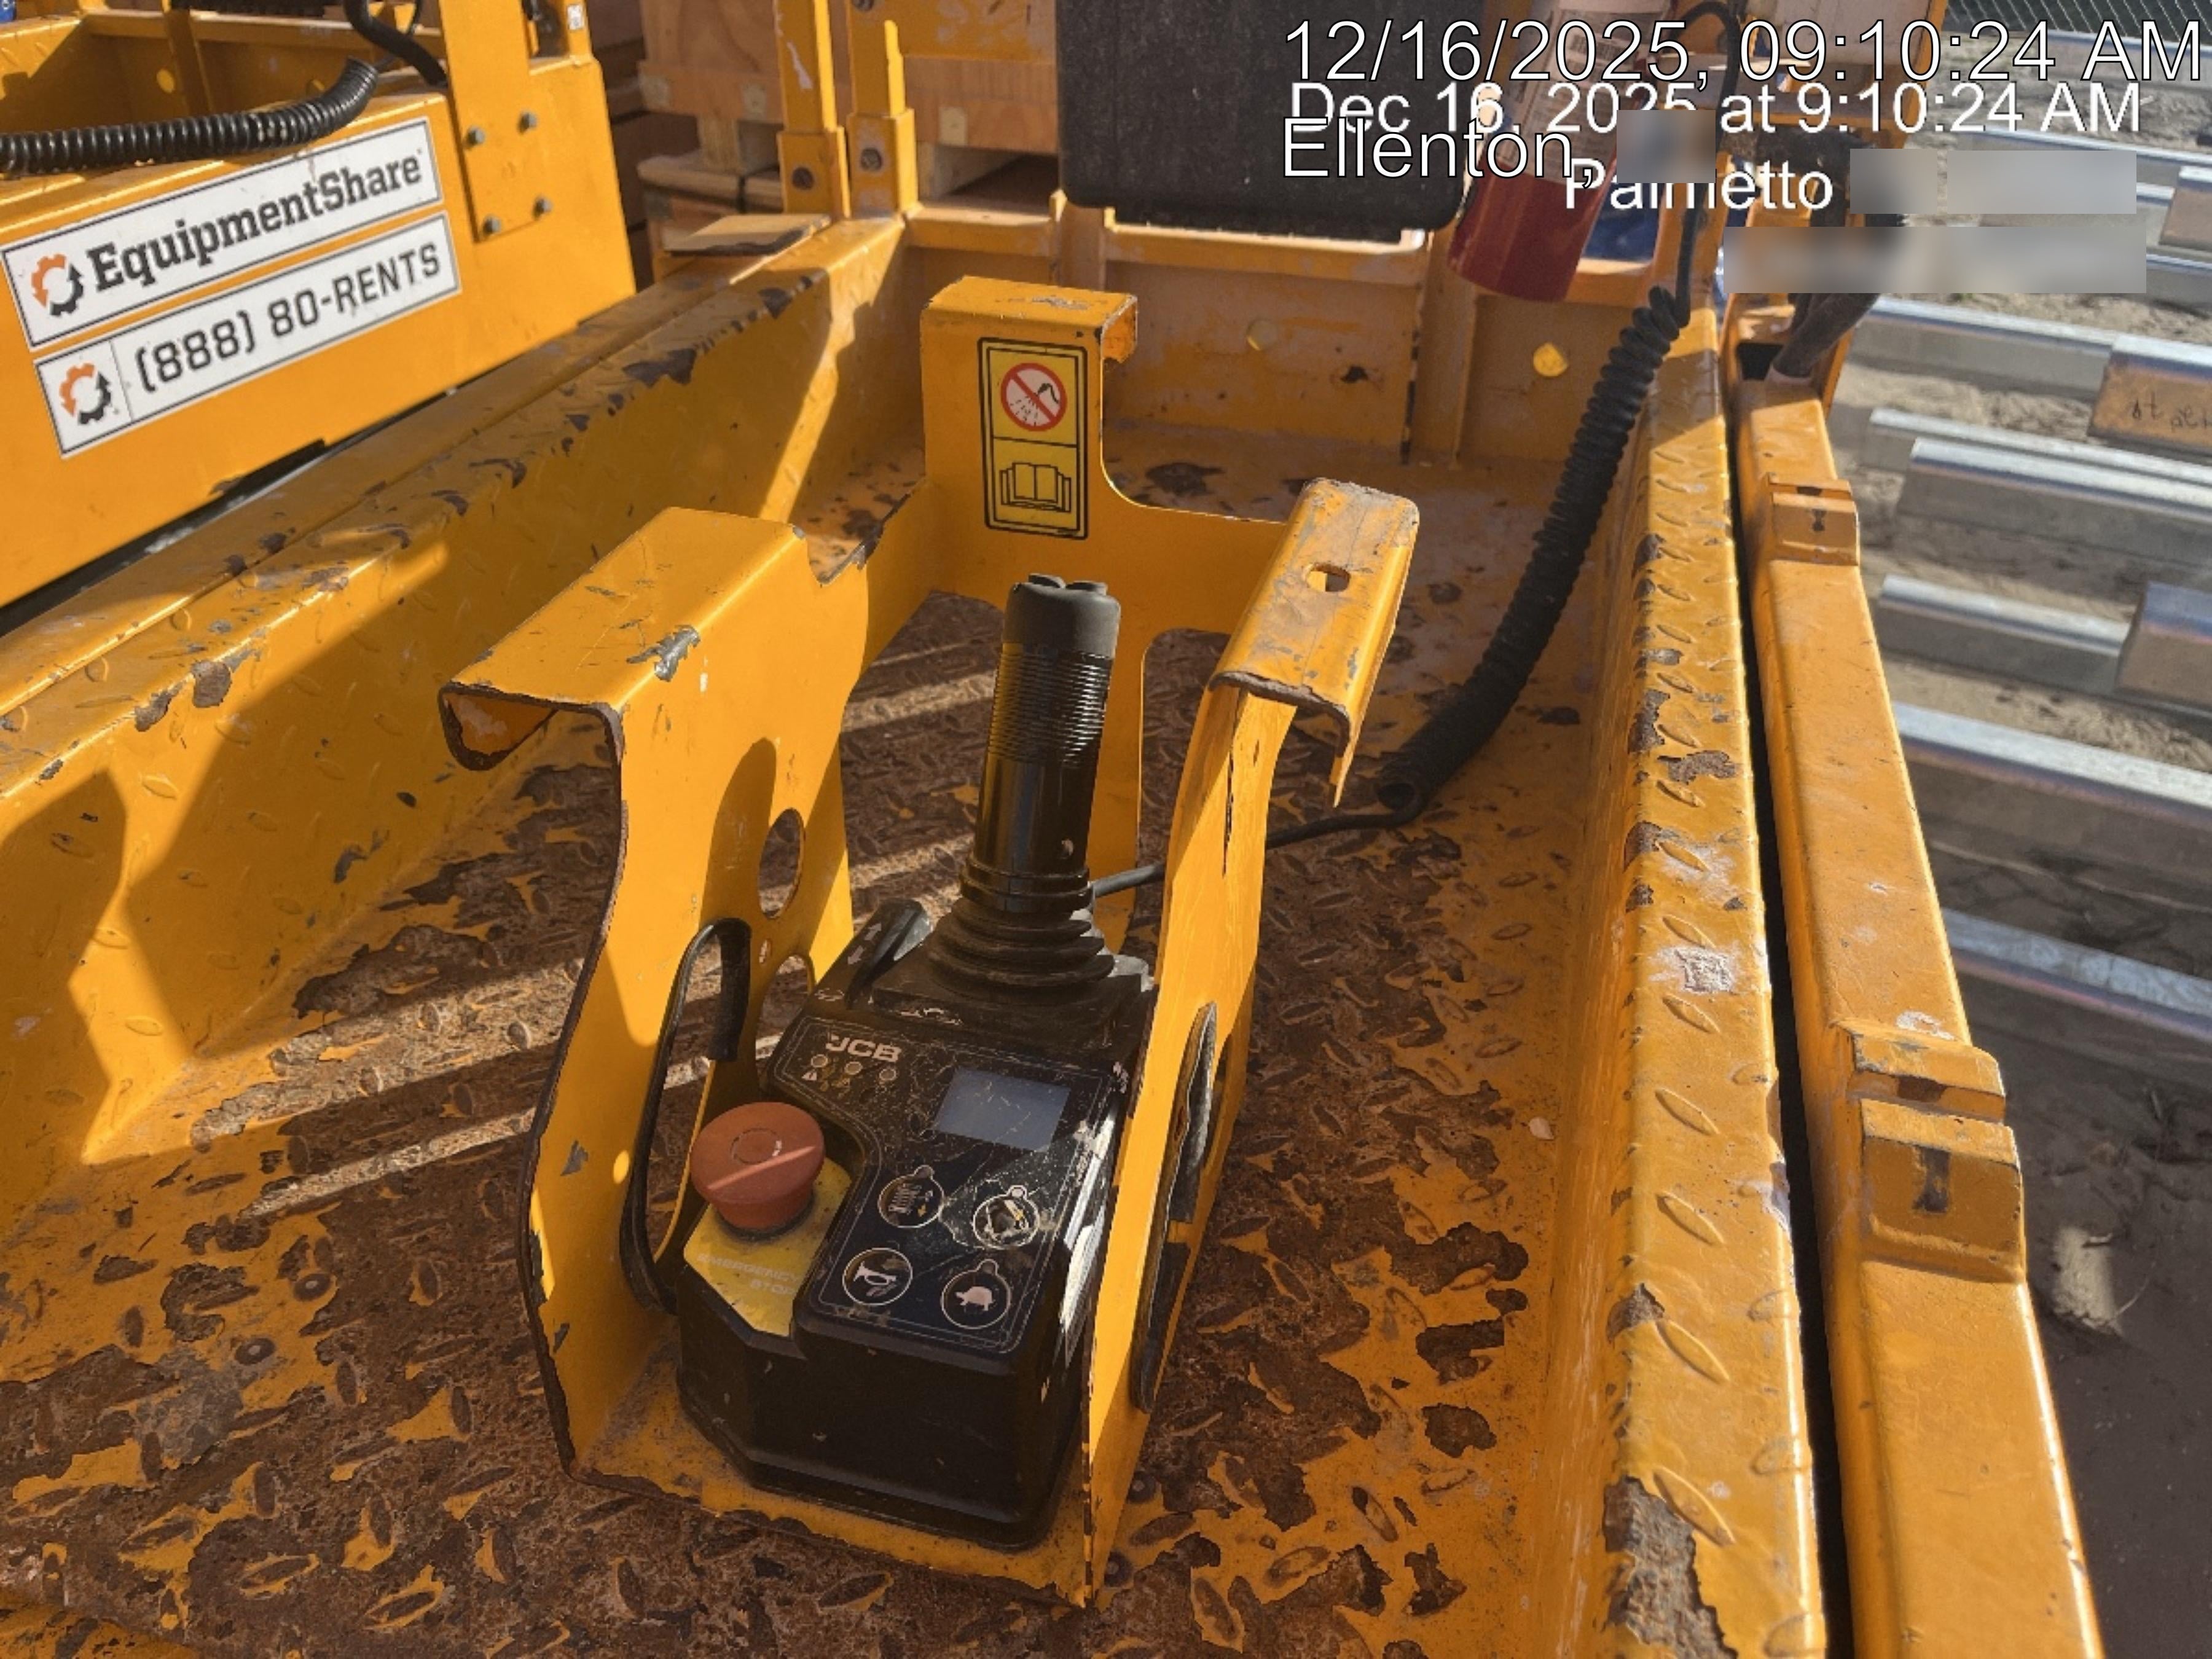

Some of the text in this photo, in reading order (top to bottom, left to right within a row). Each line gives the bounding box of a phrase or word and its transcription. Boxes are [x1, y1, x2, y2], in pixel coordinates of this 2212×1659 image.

[87, 154, 422, 292] EquipmentShare
[135, 243, 440, 393] (888) 80-RENTS
[825, 1033, 902, 1062] JCB
